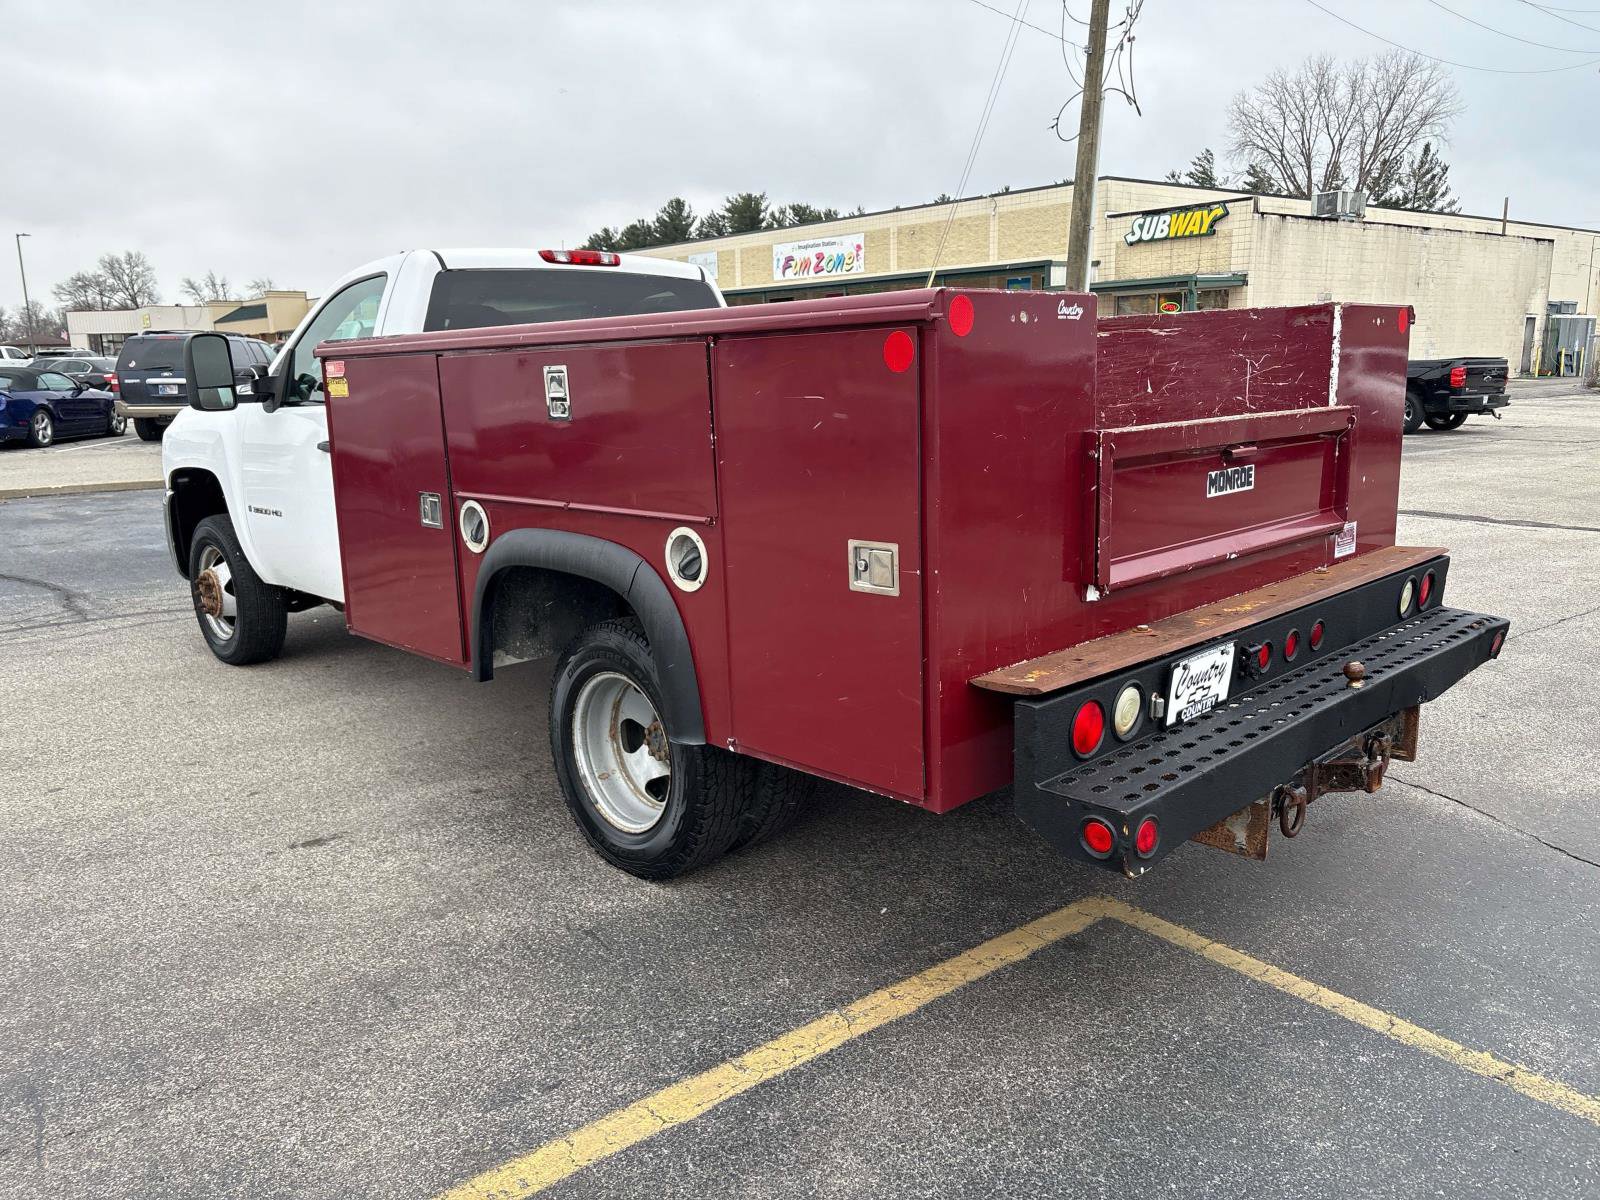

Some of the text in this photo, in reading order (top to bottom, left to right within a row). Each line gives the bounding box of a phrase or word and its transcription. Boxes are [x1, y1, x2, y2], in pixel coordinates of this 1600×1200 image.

[1124, 204, 1226, 244] SUBWAY
[782, 251, 855, 278] Fun Zone
[1058, 299, 1083, 320] Country
[1161, 303, 1178, 312] OPEN
[1208, 465, 1253, 495] MONROE
[1175, 660, 1228, 700] Country
[1181, 696, 1218, 720] COUNTRY
